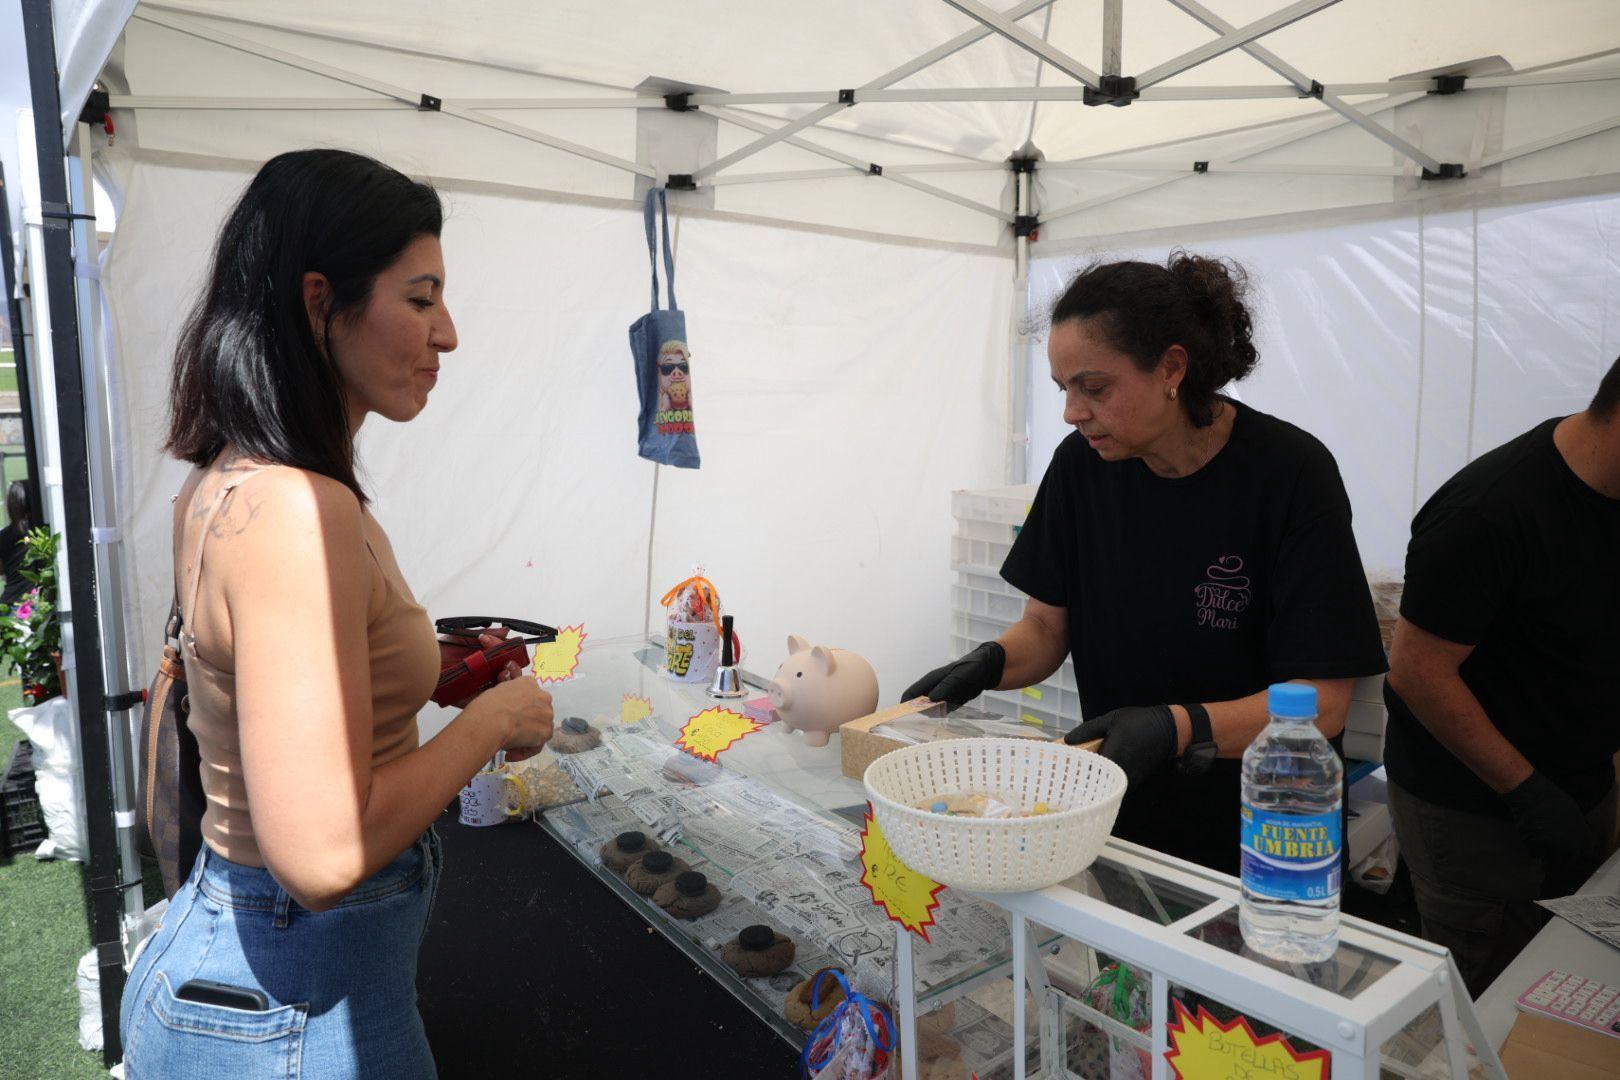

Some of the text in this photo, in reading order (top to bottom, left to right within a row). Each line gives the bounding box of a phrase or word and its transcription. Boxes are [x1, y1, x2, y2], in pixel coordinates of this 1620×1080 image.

[1197, 608, 1239, 629] Mari
[1261, 823, 1328, 841] FUENTE
[1253, 834, 1335, 858] UMBRIA
